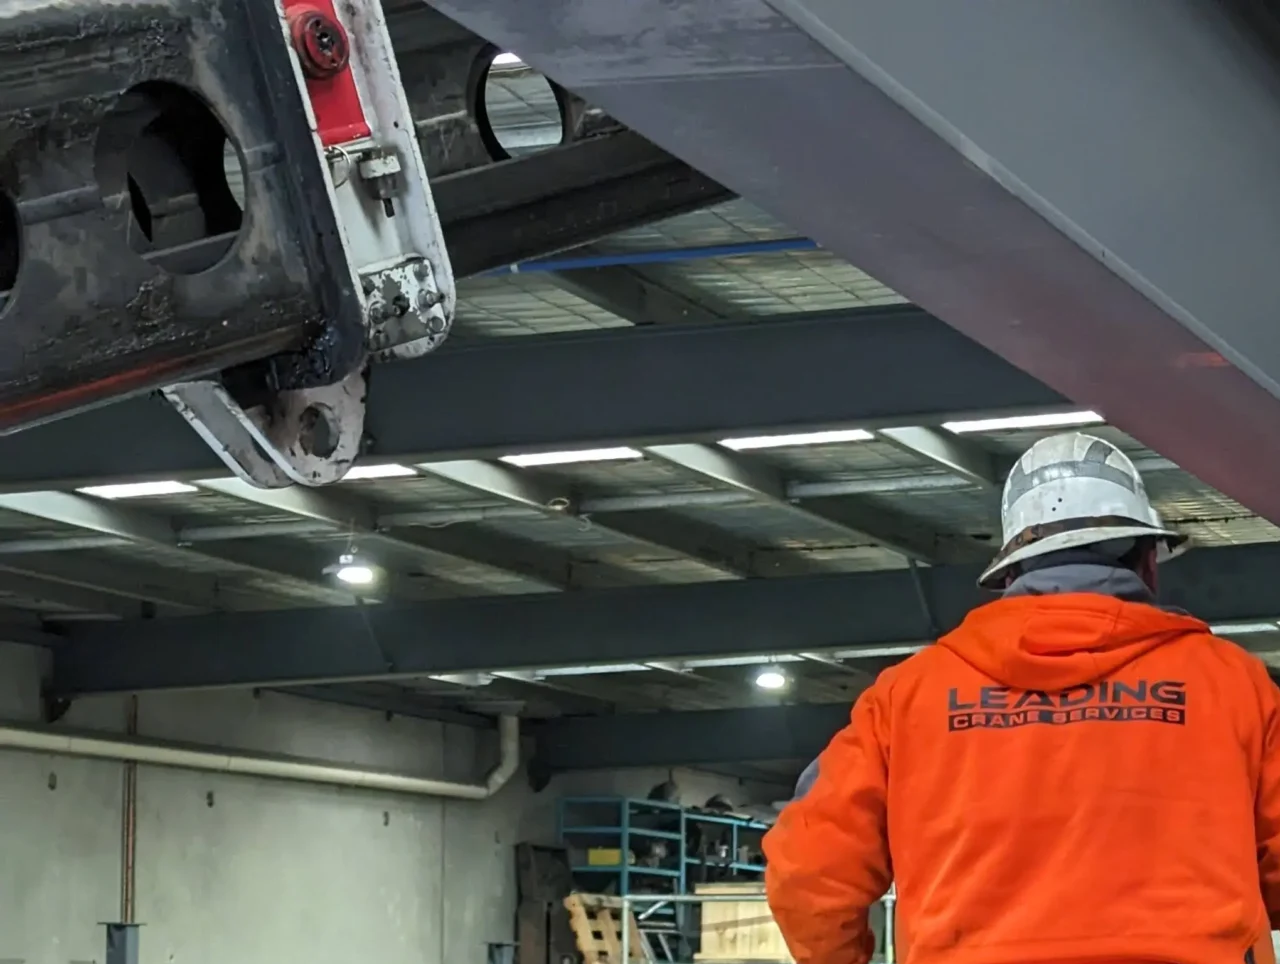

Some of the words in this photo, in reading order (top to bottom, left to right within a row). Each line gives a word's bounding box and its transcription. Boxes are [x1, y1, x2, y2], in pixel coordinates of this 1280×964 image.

[948, 680, 1186, 711] LEADING
[953, 711, 1040, 729] CRANE
[1054, 707, 1181, 725] SERVICES
